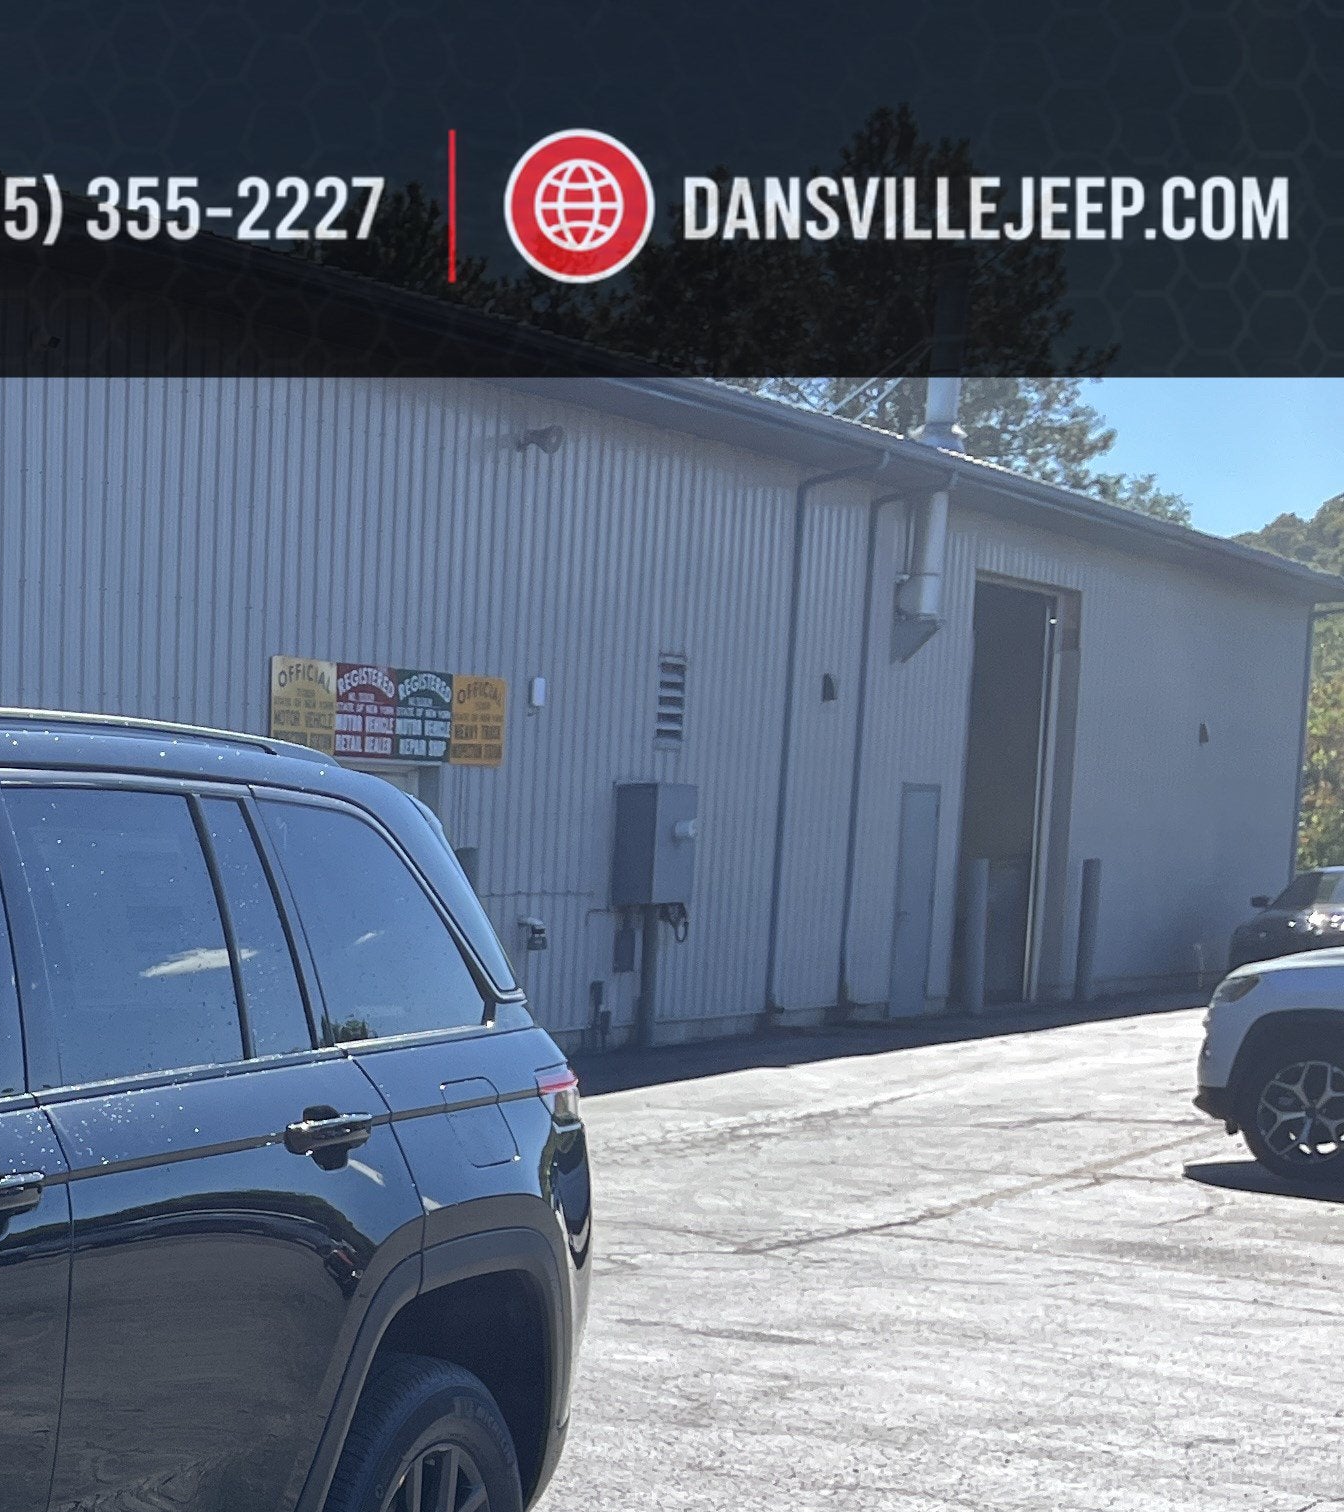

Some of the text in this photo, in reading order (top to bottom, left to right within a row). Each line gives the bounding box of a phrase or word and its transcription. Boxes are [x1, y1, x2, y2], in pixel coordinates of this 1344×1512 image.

[278, 663, 331, 694] OFFICIAL
[337, 667, 395, 699] REGISTERED
[398, 673, 452, 703] REGISTERED
[457, 681, 502, 707] OFFICIAL
